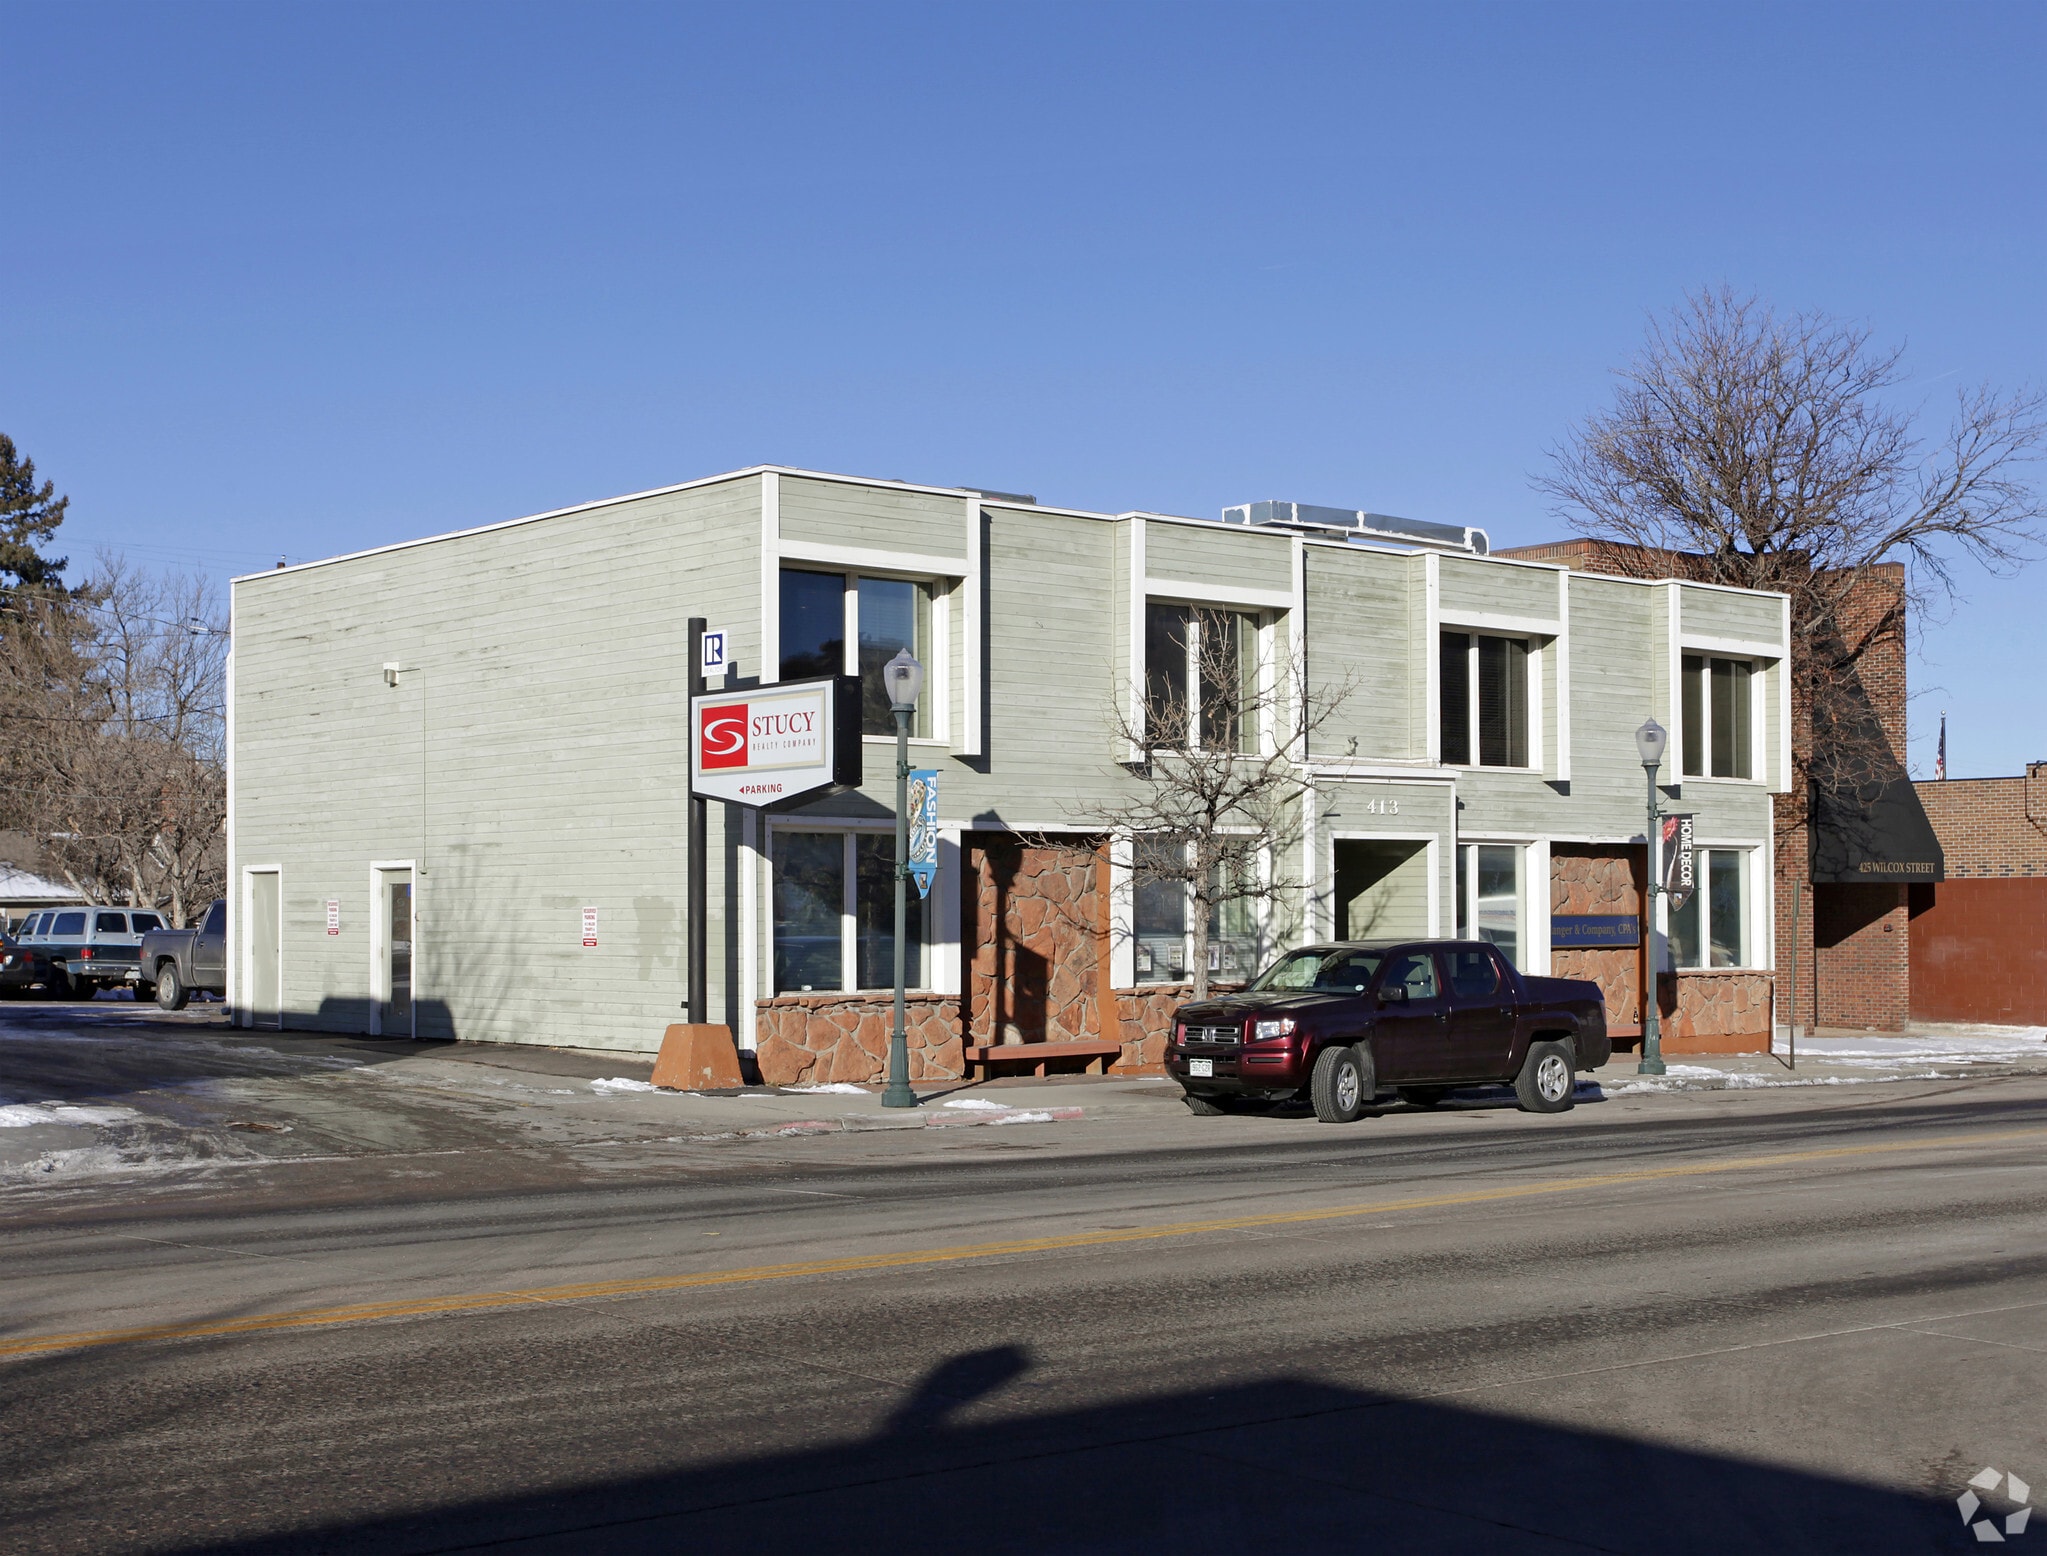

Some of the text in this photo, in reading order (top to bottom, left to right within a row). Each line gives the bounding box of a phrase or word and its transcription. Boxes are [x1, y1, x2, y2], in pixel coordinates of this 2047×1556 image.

[752, 711, 815, 737] STUCY
[752, 738, 816, 751] REALTY COMPANY
[745, 783, 783, 795] PARKING
[1367, 798, 1399, 815] 413
[926, 776, 937, 864] FASHION
[1680, 819, 1692, 887] HOME DECOR
[1858, 862, 1936, 873] 425 WILCOX STREET
[1574, 924, 1580, 935] &
[1582, 924, 1616, 937] Company,
